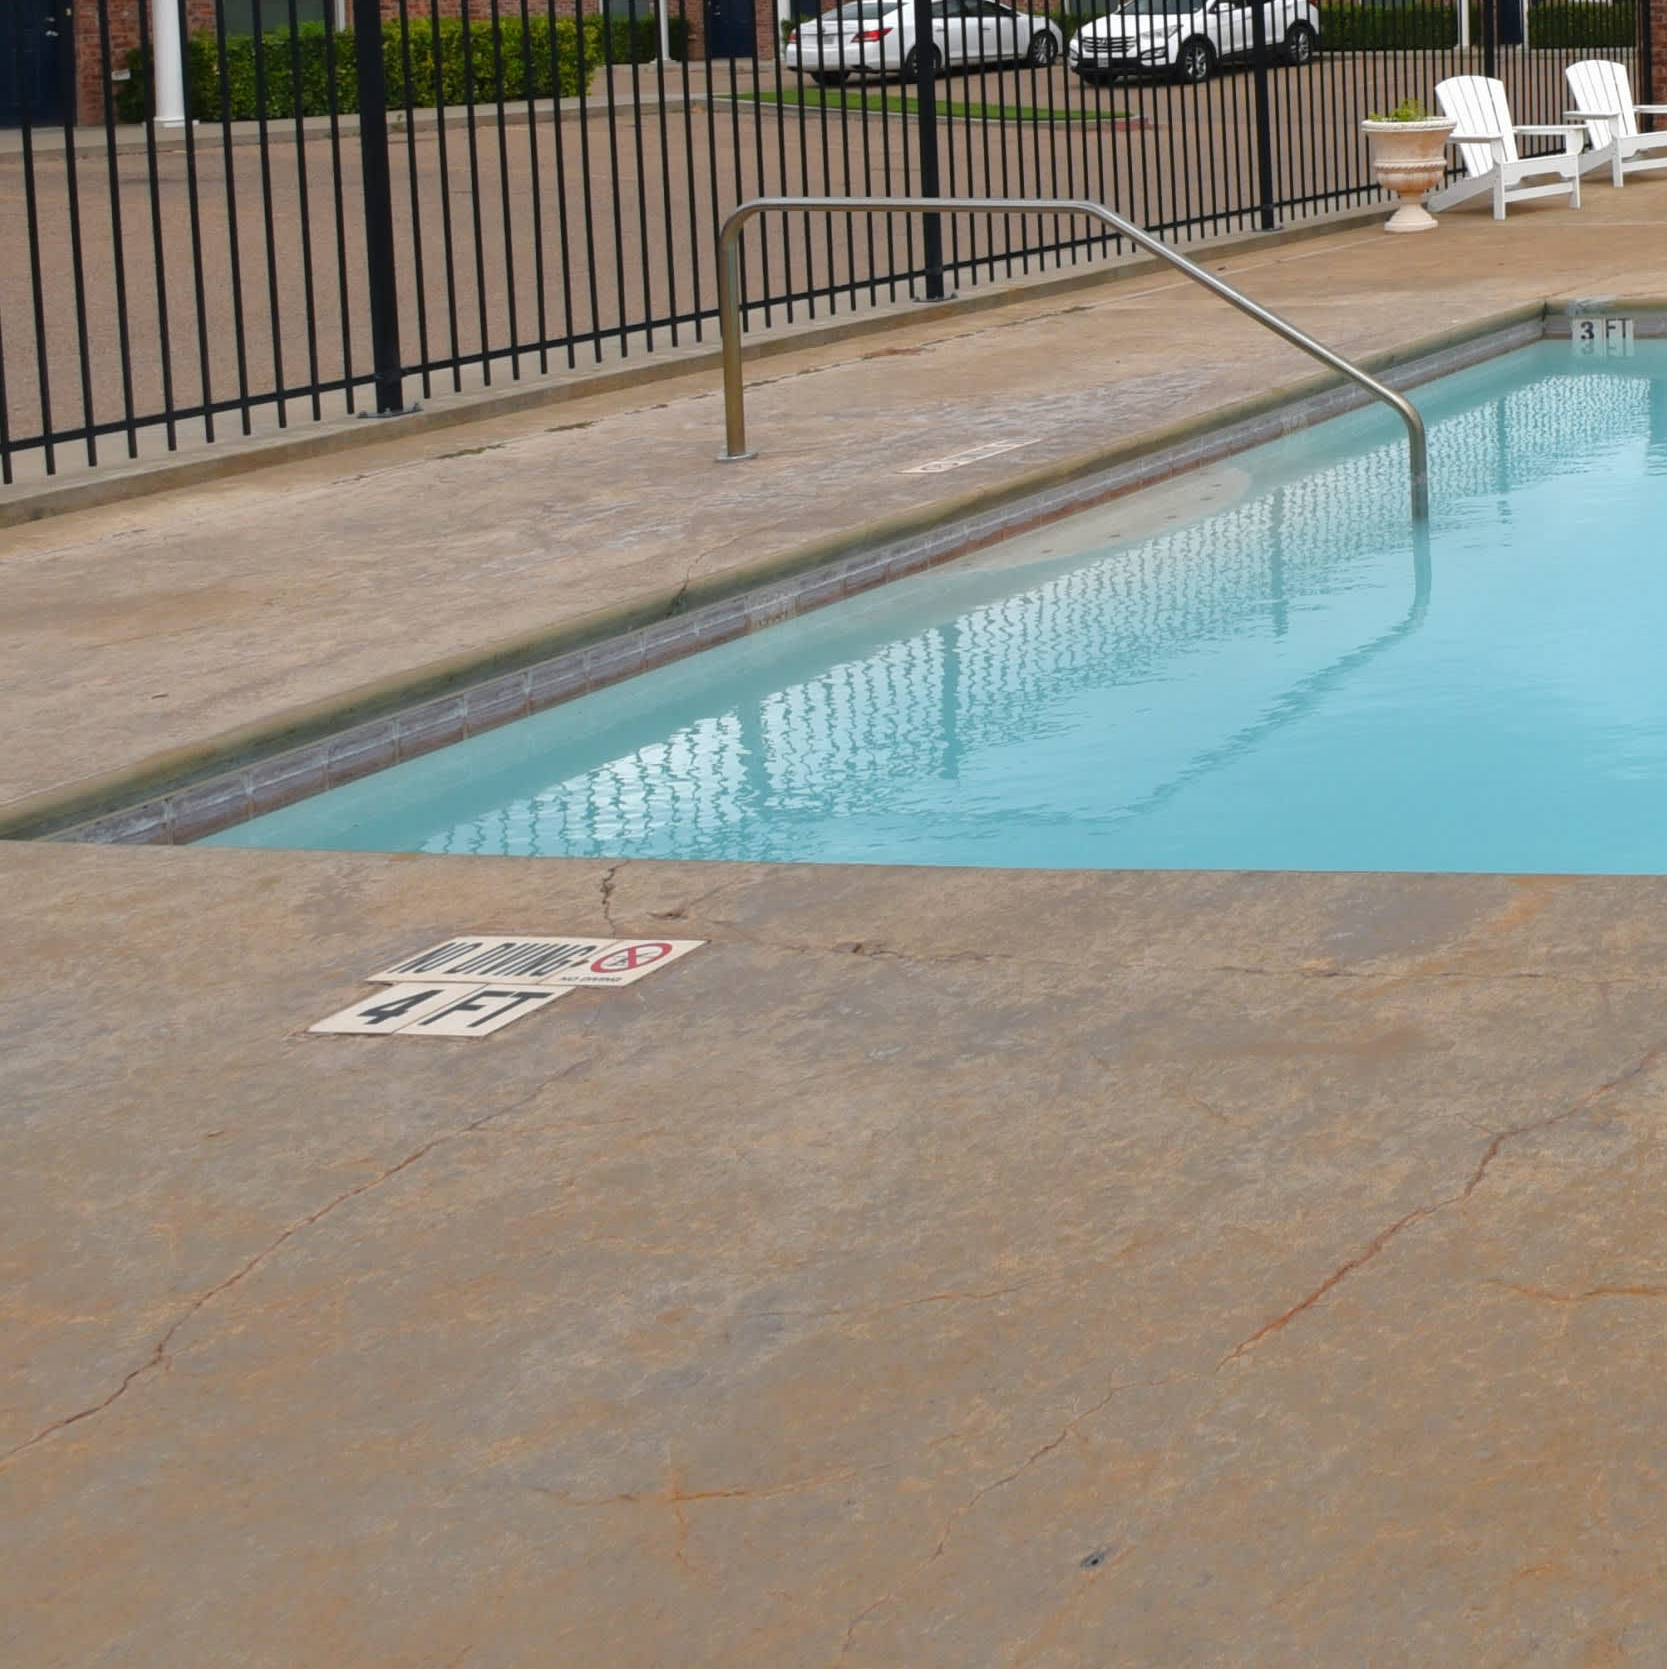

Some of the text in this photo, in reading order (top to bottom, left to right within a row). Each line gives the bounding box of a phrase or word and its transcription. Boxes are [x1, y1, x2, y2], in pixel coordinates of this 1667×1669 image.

[1580, 317, 1630, 340] 3 FT
[386, 941, 597, 976] NO DIVING
[357, 989, 554, 1028] 4 FT
